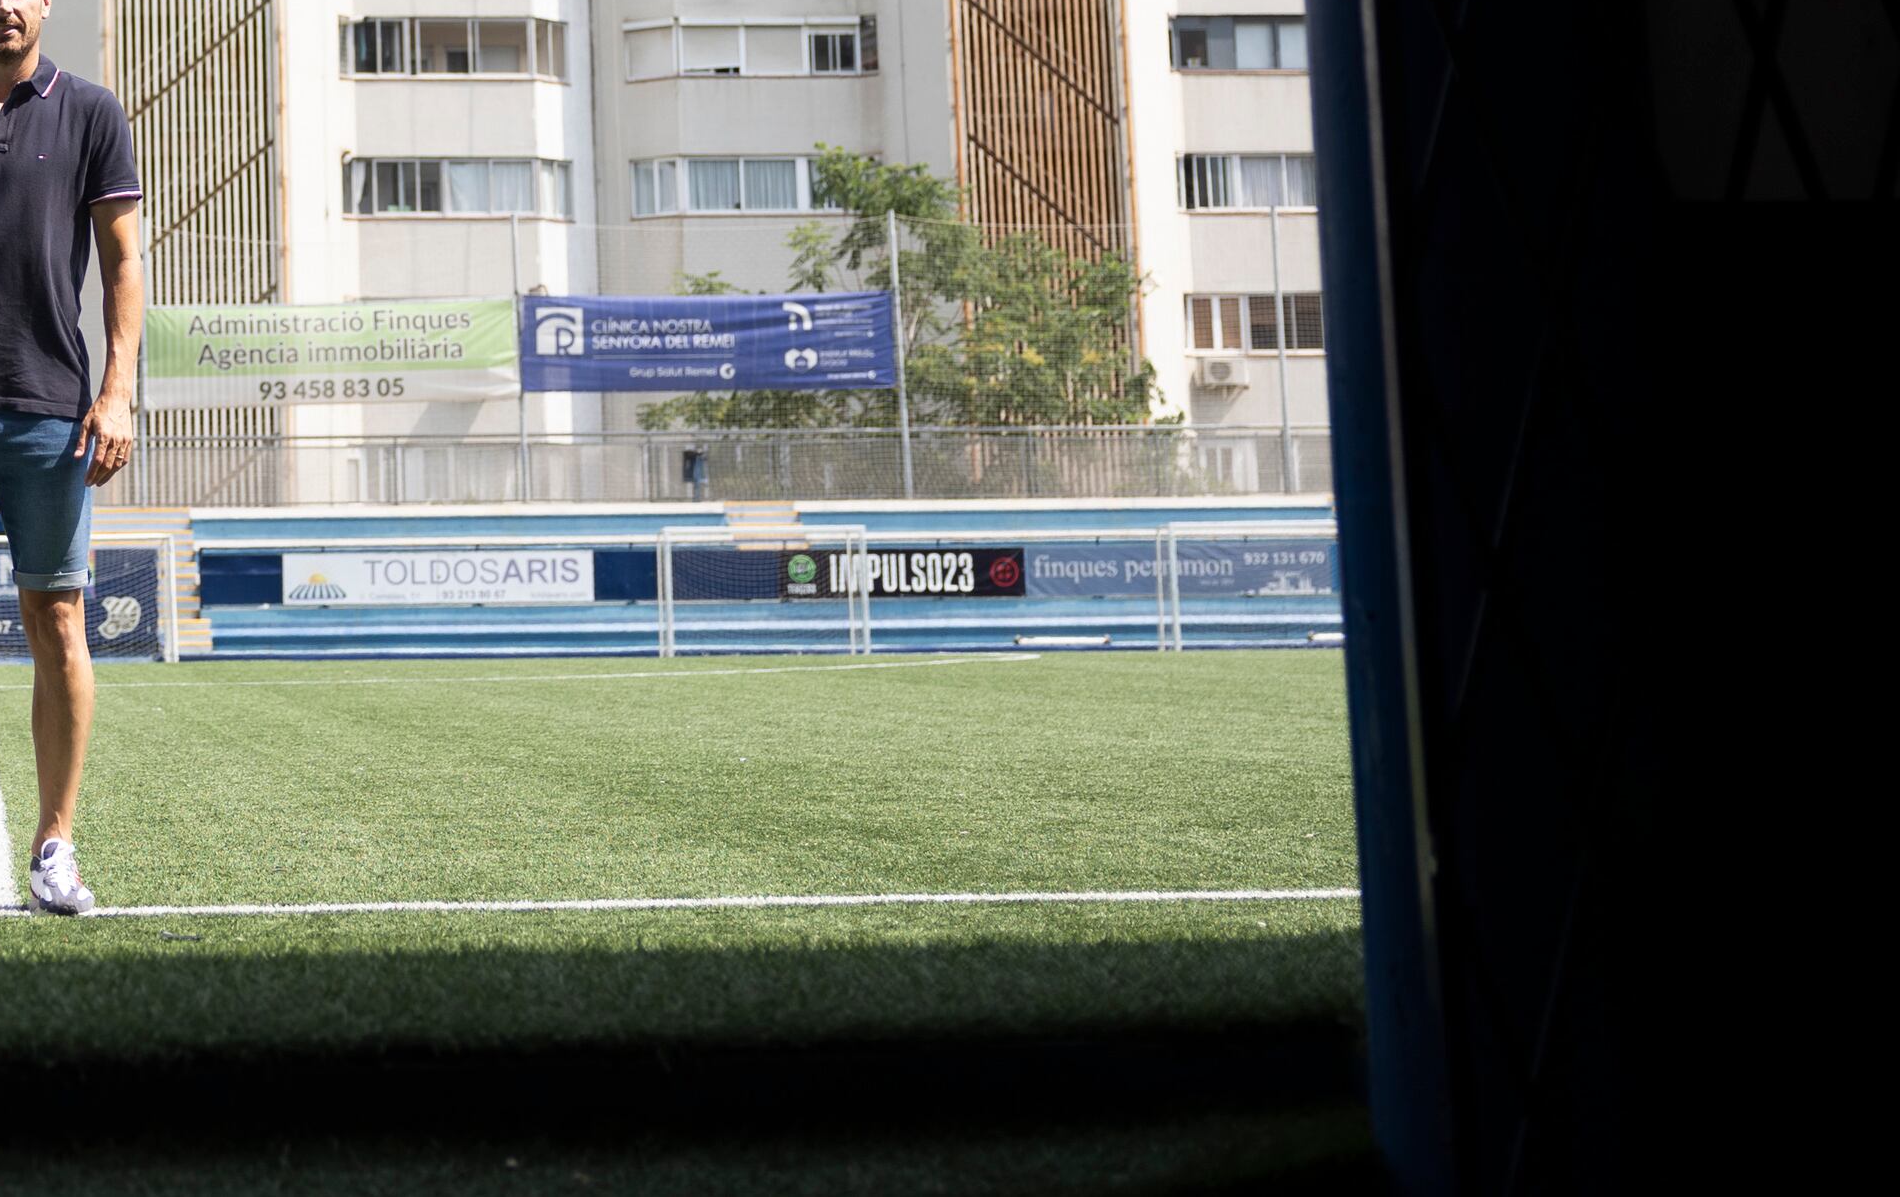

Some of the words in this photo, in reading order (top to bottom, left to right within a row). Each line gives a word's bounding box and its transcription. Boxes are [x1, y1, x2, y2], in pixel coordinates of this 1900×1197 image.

[188, 310, 363, 336] Administració
[373, 310, 471, 334] Finques
[591, 317, 650, 334] CLÍNICA
[652, 318, 713, 333] NOSTRA
[591, 335, 661, 350] SENYORA
[665, 334, 690, 349] DEL
[692, 333, 736, 349] REMEI
[198, 341, 299, 370] Agència
[307, 339, 463, 364] immobiliària
[259, 381, 287, 401] 93
[293, 380, 336, 400] 458
[343, 379, 371, 398] 83
[377, 378, 405, 397] 05
[1033, 555, 1119, 584] finques
